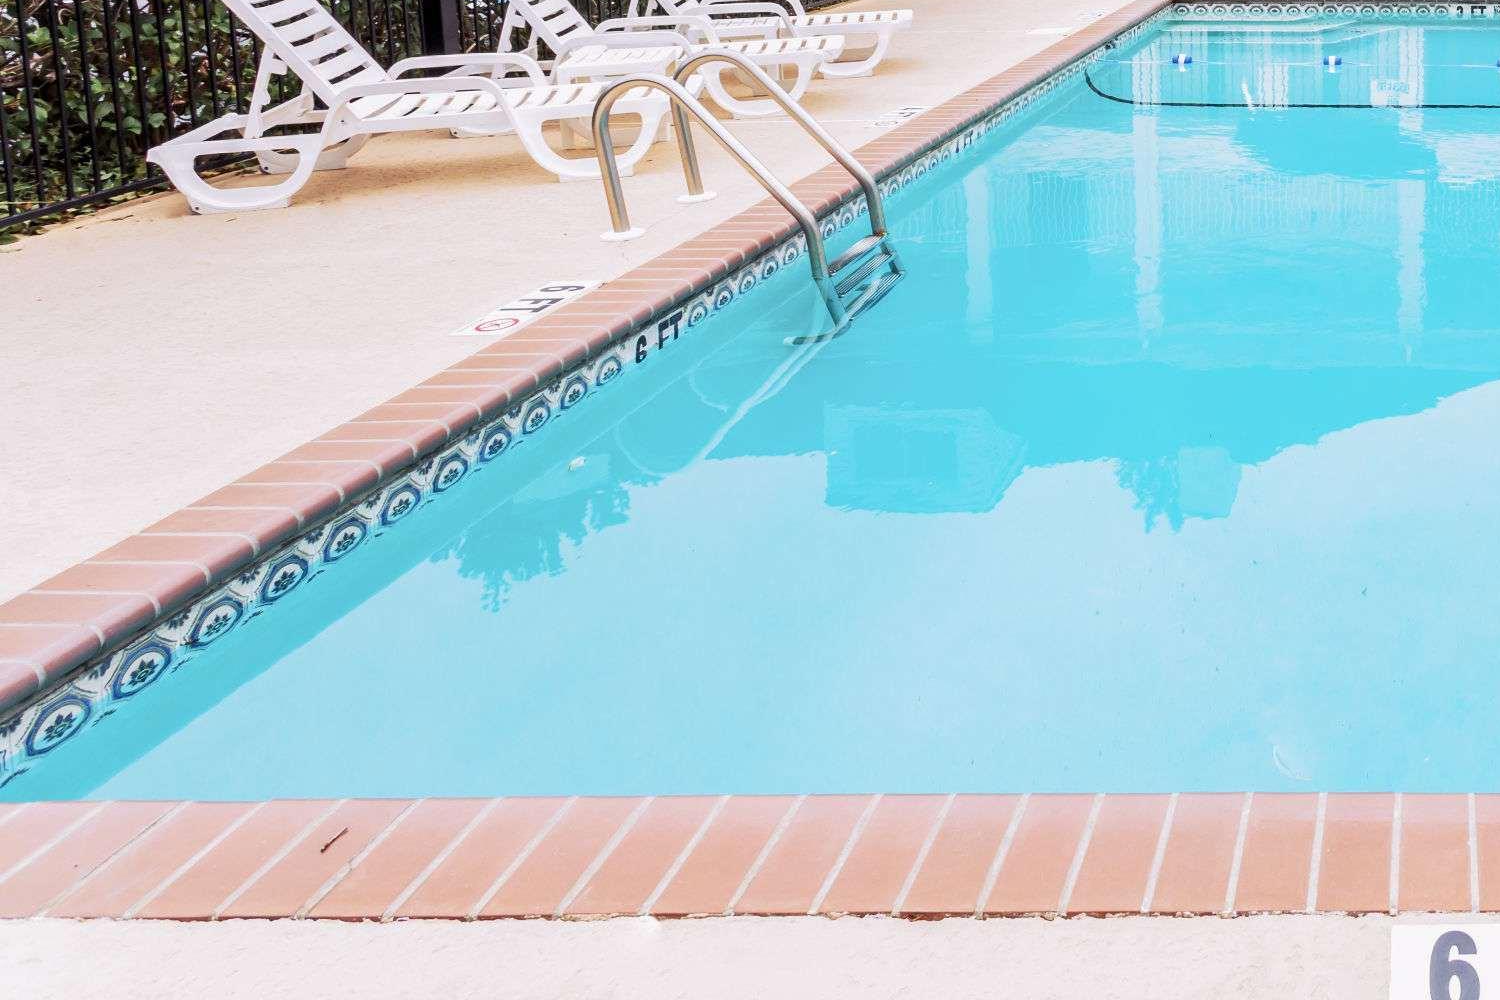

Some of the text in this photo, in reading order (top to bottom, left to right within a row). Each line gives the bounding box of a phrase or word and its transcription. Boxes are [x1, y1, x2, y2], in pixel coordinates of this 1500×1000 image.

[500, 285, 586, 313] 6 FT
[635, 310, 683, 364] 6 FT
[1429, 930, 1481, 1000] 6
